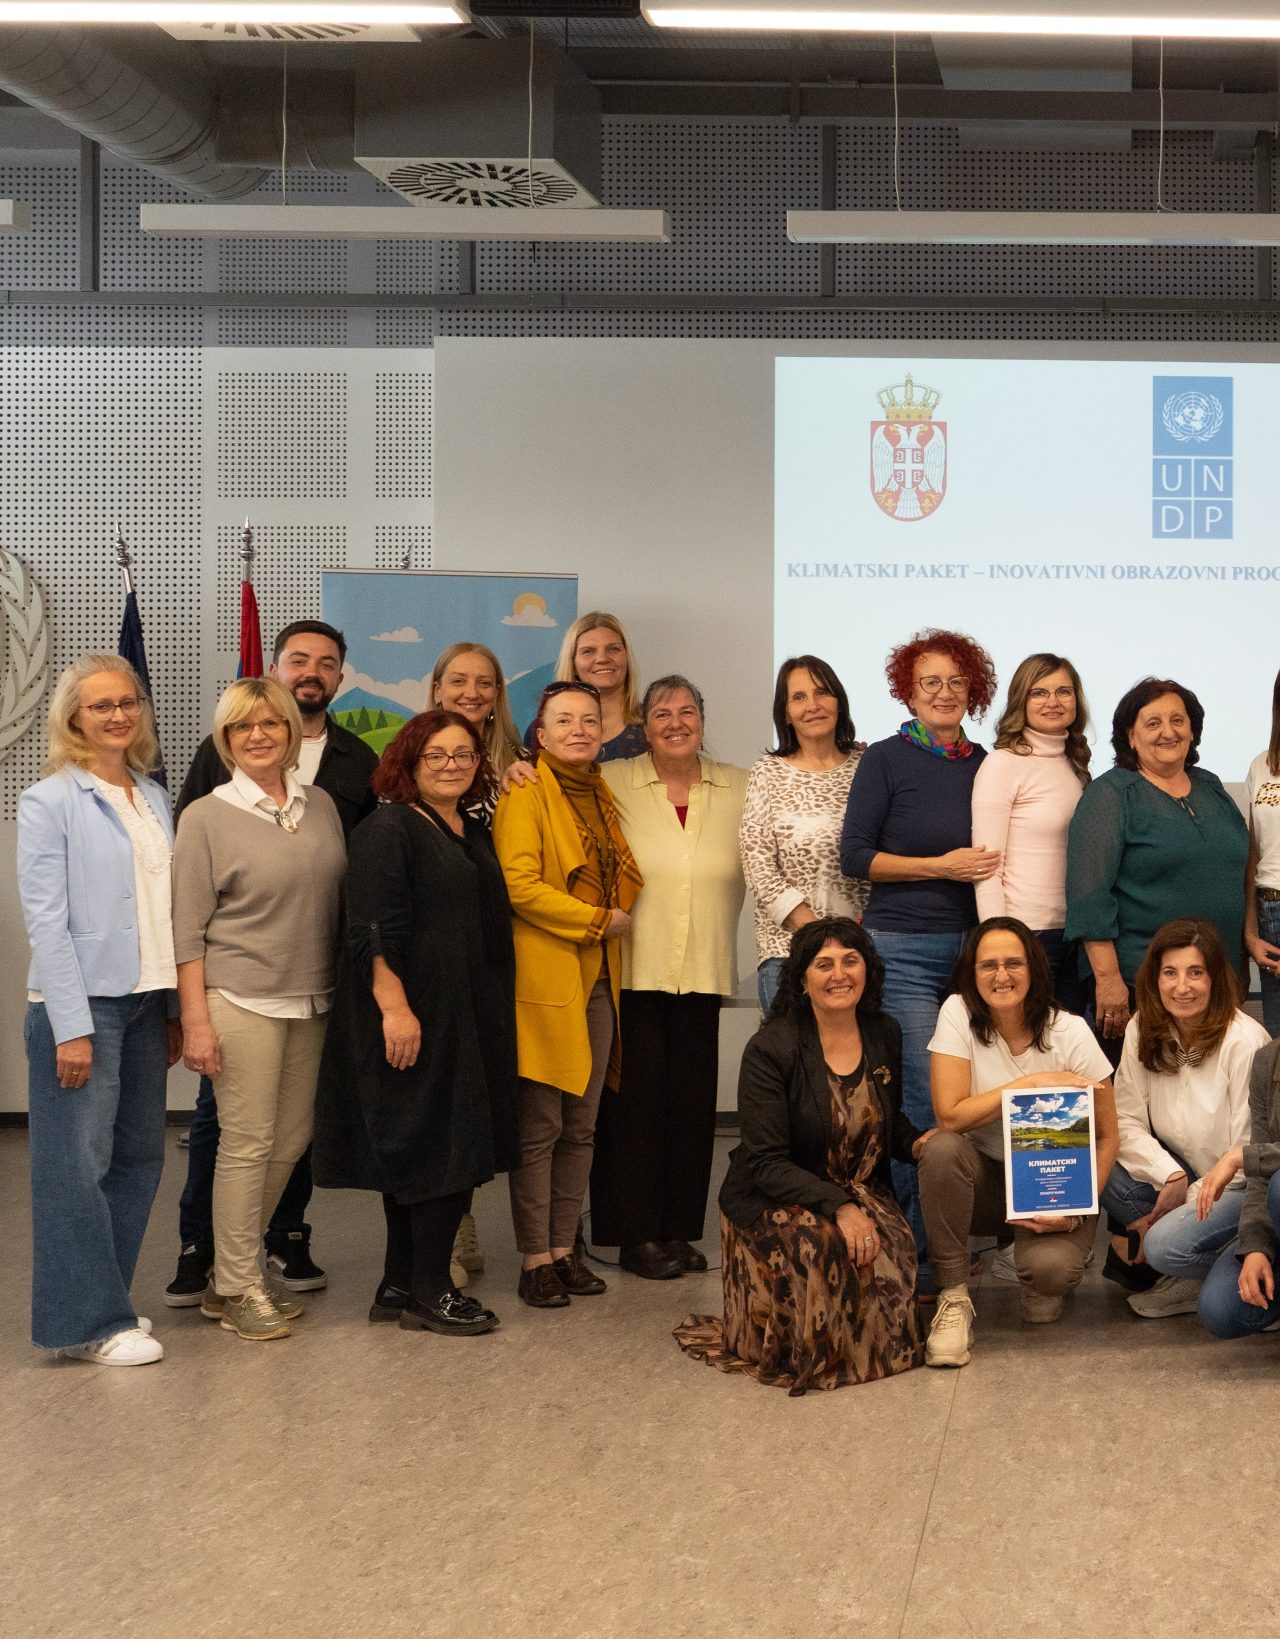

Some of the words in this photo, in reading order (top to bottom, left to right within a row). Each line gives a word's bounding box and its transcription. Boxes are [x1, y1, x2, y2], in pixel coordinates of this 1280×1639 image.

[787, 563, 899, 578] KLIMATSKI
[904, 563, 969, 579] PAKET
[989, 564, 1106, 580] INOVATIVNI
[1111, 565, 1227, 581] OBRAZOVNI
[1028, 1158, 1077, 1167] КЛИМАТСКИ
